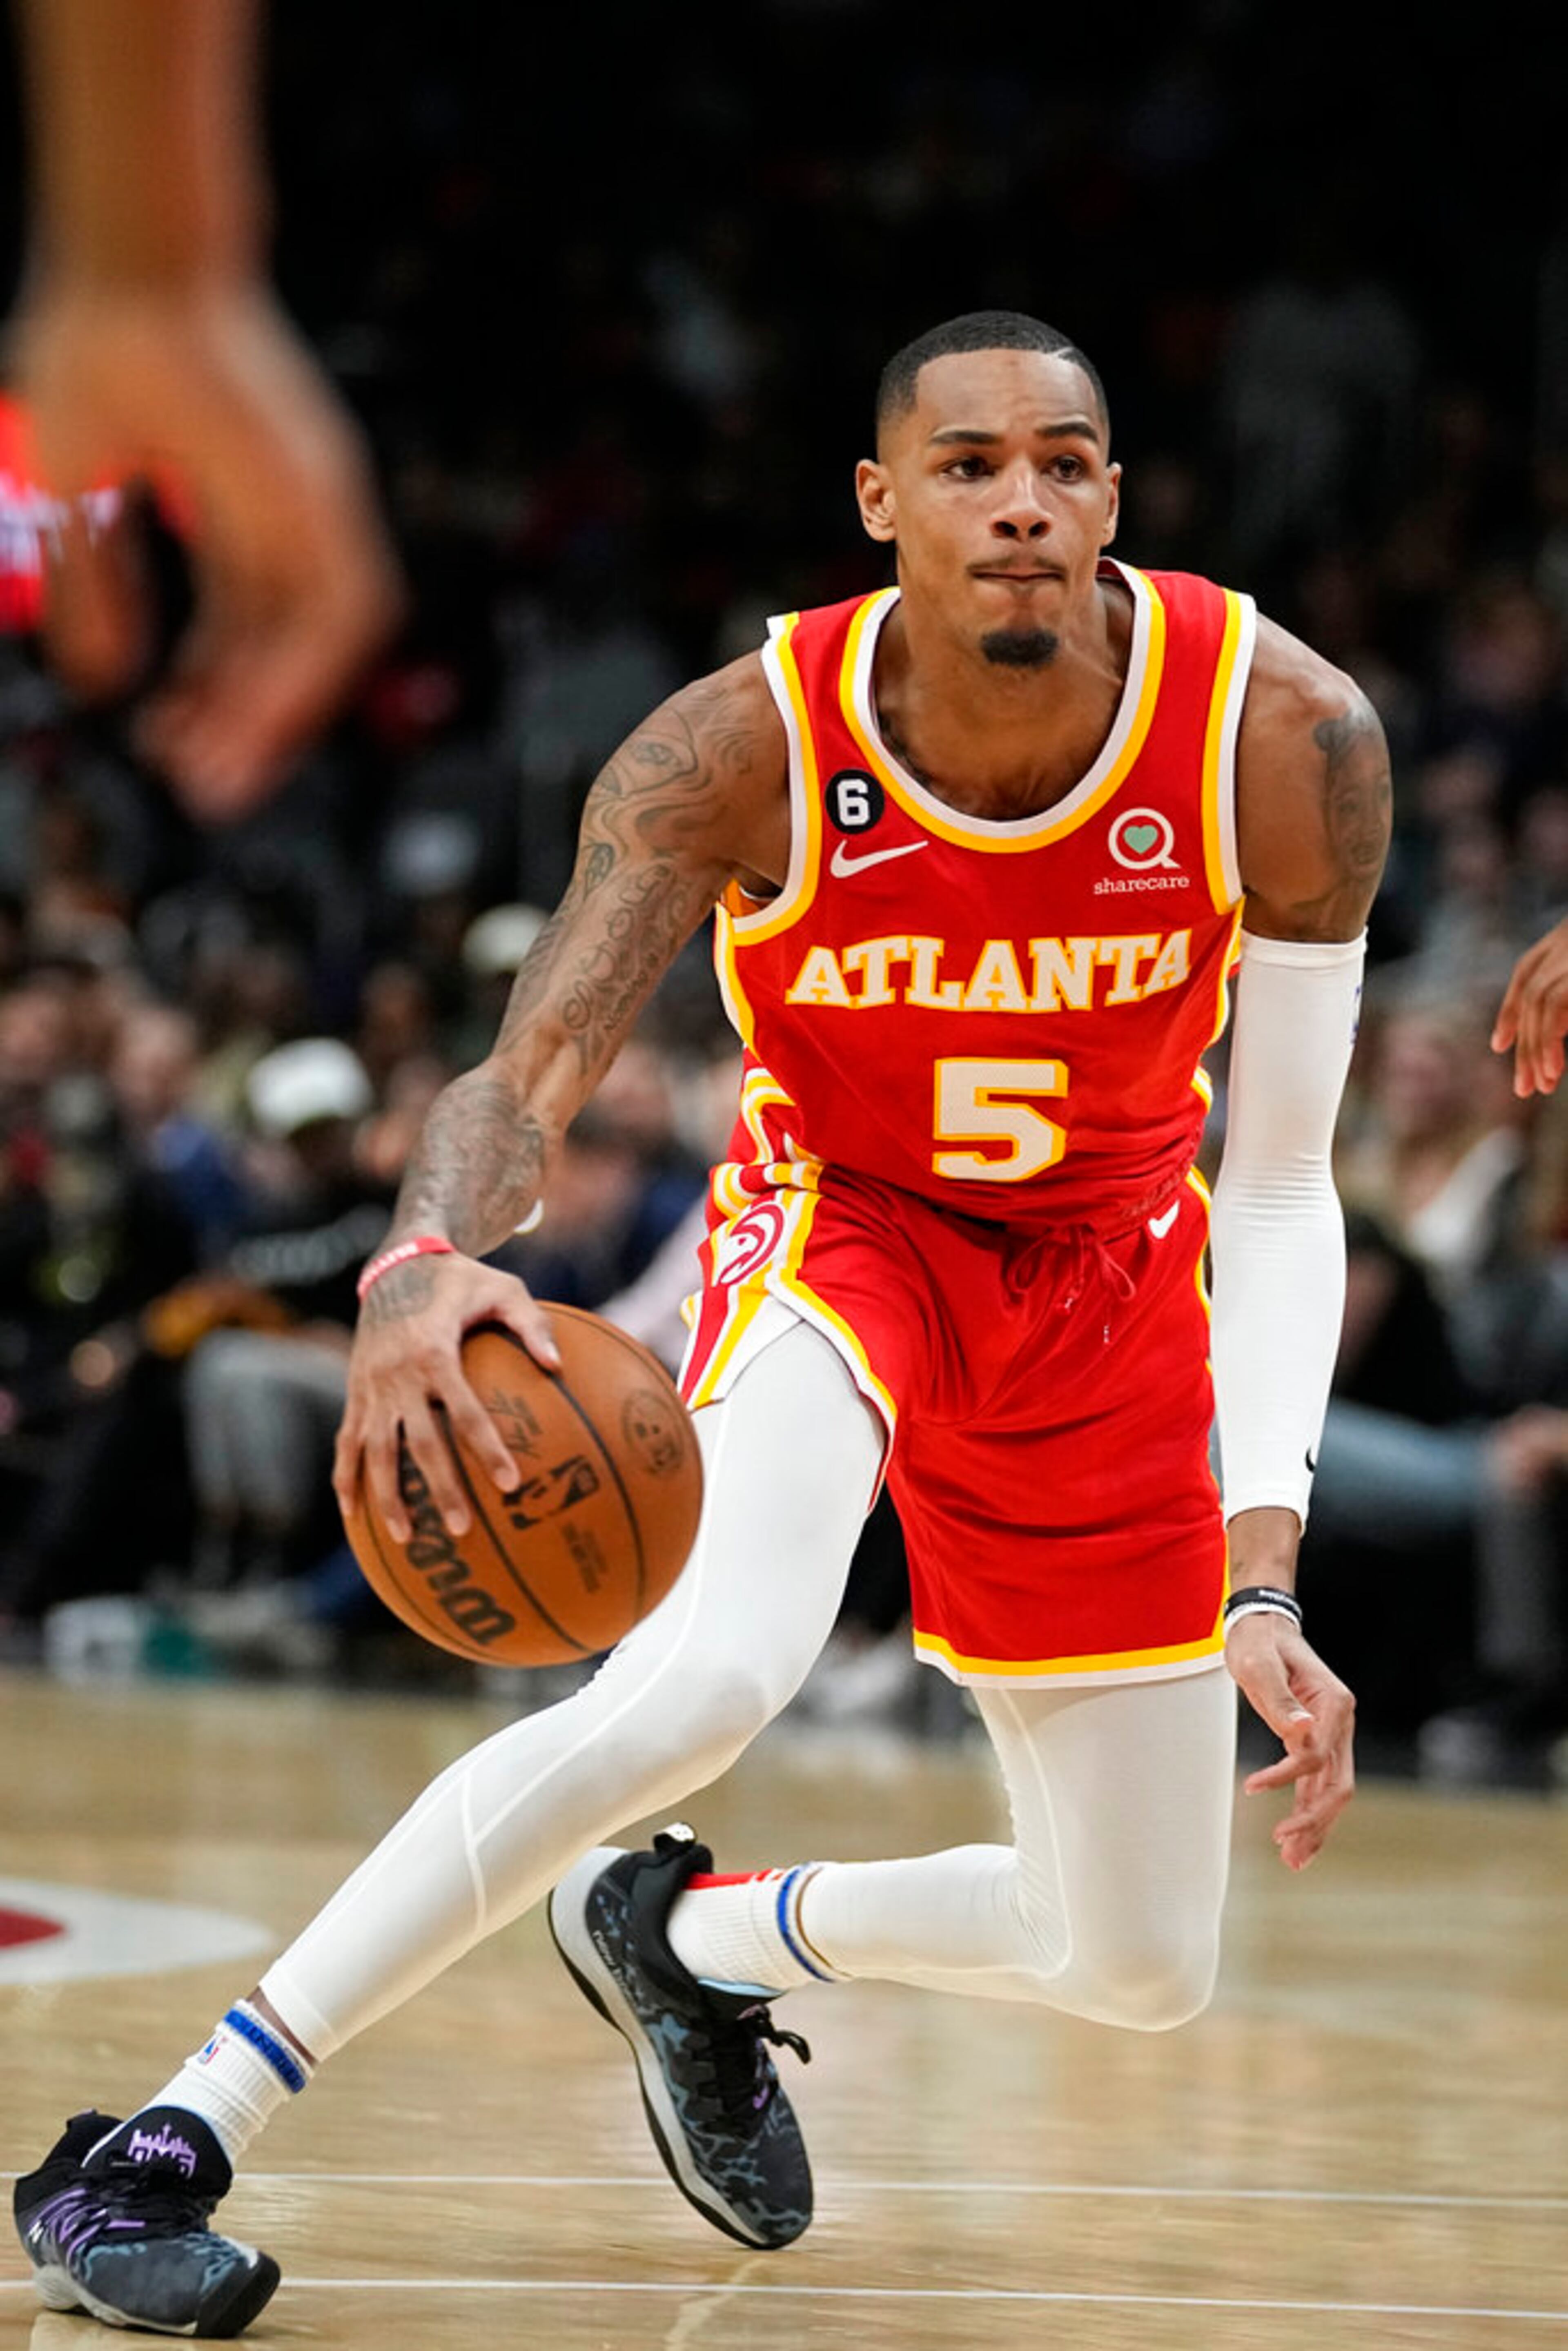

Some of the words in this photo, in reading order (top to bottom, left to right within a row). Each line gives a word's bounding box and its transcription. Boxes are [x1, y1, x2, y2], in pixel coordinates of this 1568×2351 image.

[837, 778, 871, 826] 6
[1094, 876, 1190, 895] sharecare
[785, 929, 1193, 1014] ATLANTA
[932, 1056, 1069, 1182] 5
